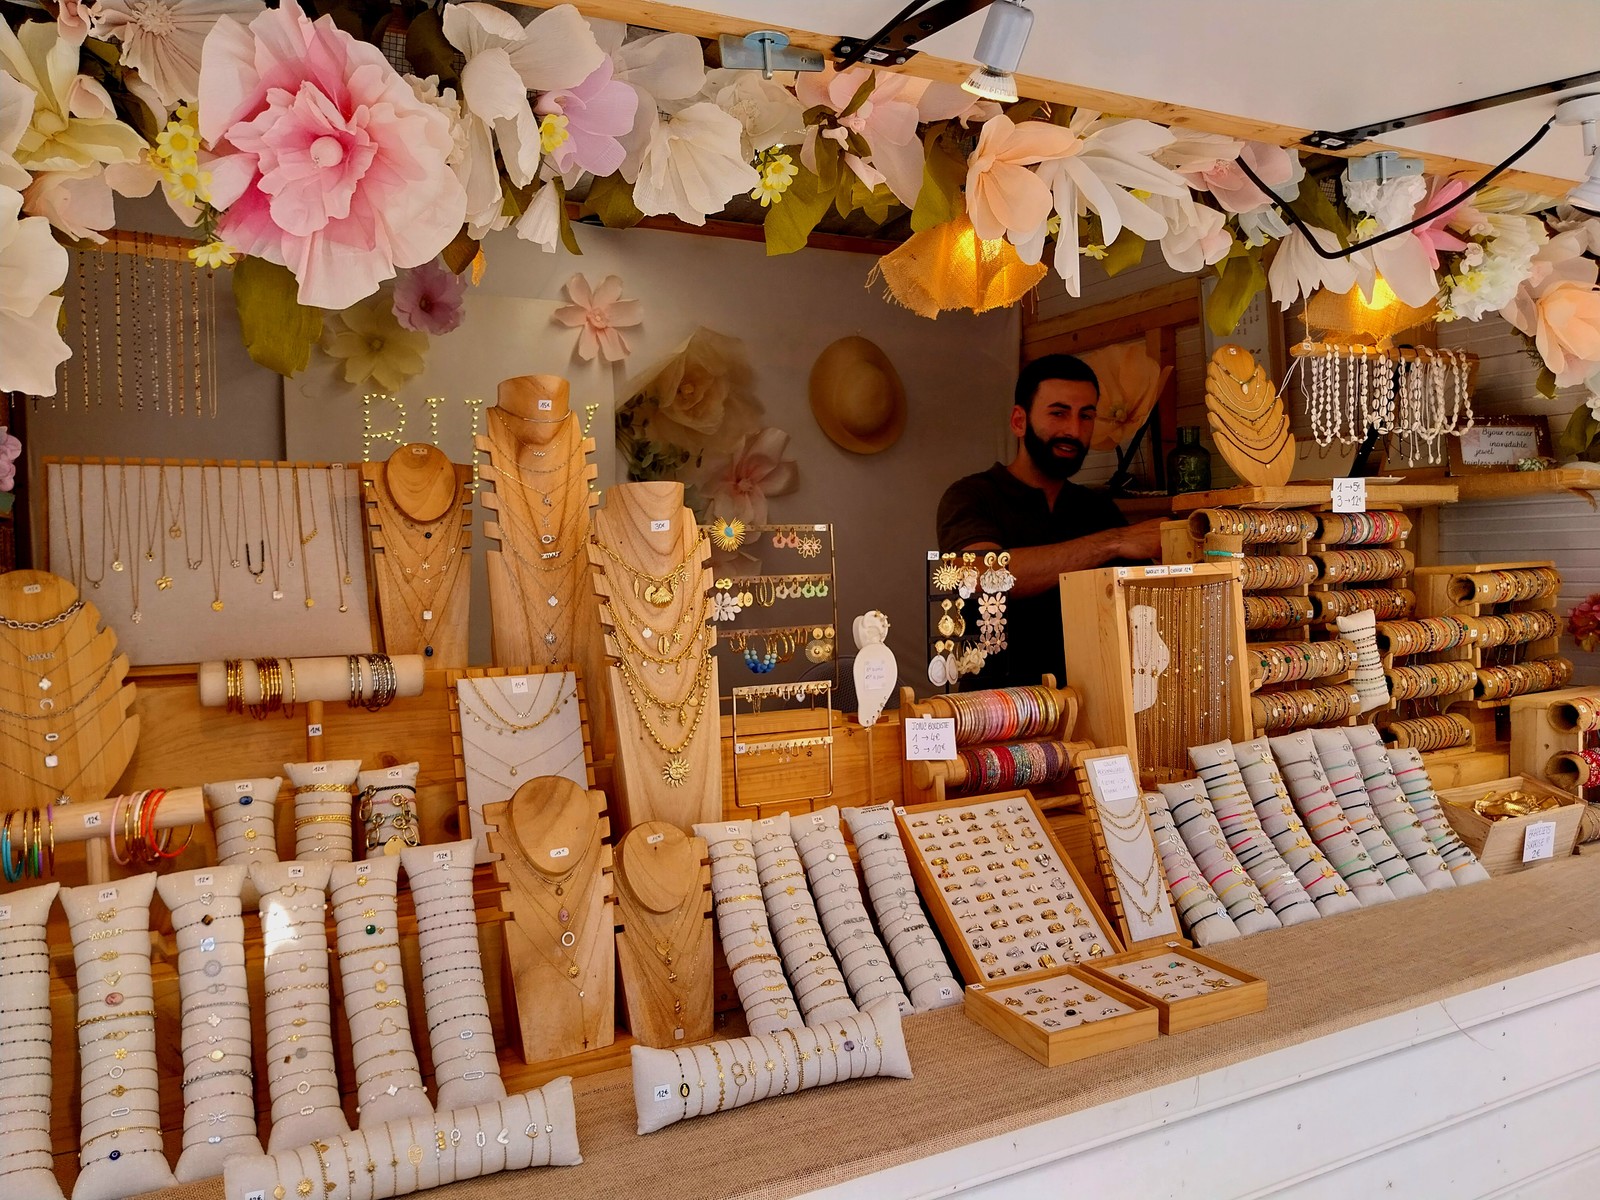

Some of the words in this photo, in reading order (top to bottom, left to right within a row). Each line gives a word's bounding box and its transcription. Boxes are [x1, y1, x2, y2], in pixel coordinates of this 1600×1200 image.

[1481, 429, 1503, 438] Bijoux
[1516, 429, 1532, 437] acier
[1474, 448, 1494, 457] jewel
[1337, 482, 1342, 492] 1
[1353, 481, 1361, 492] 5€
[1337, 494, 1343, 507] 3
[912, 733, 917, 742] 1
[931, 733, 941, 741] 4€
[913, 744, 920, 755] 3
[87, 815, 98, 825] 12€
[437, 851, 448, 859] 12€
[1531, 849, 1541, 859] 2€
[358, 865, 369, 873] 12€
[198, 876, 210, 884] 12€
[656, 1088, 669, 1099] 12€
